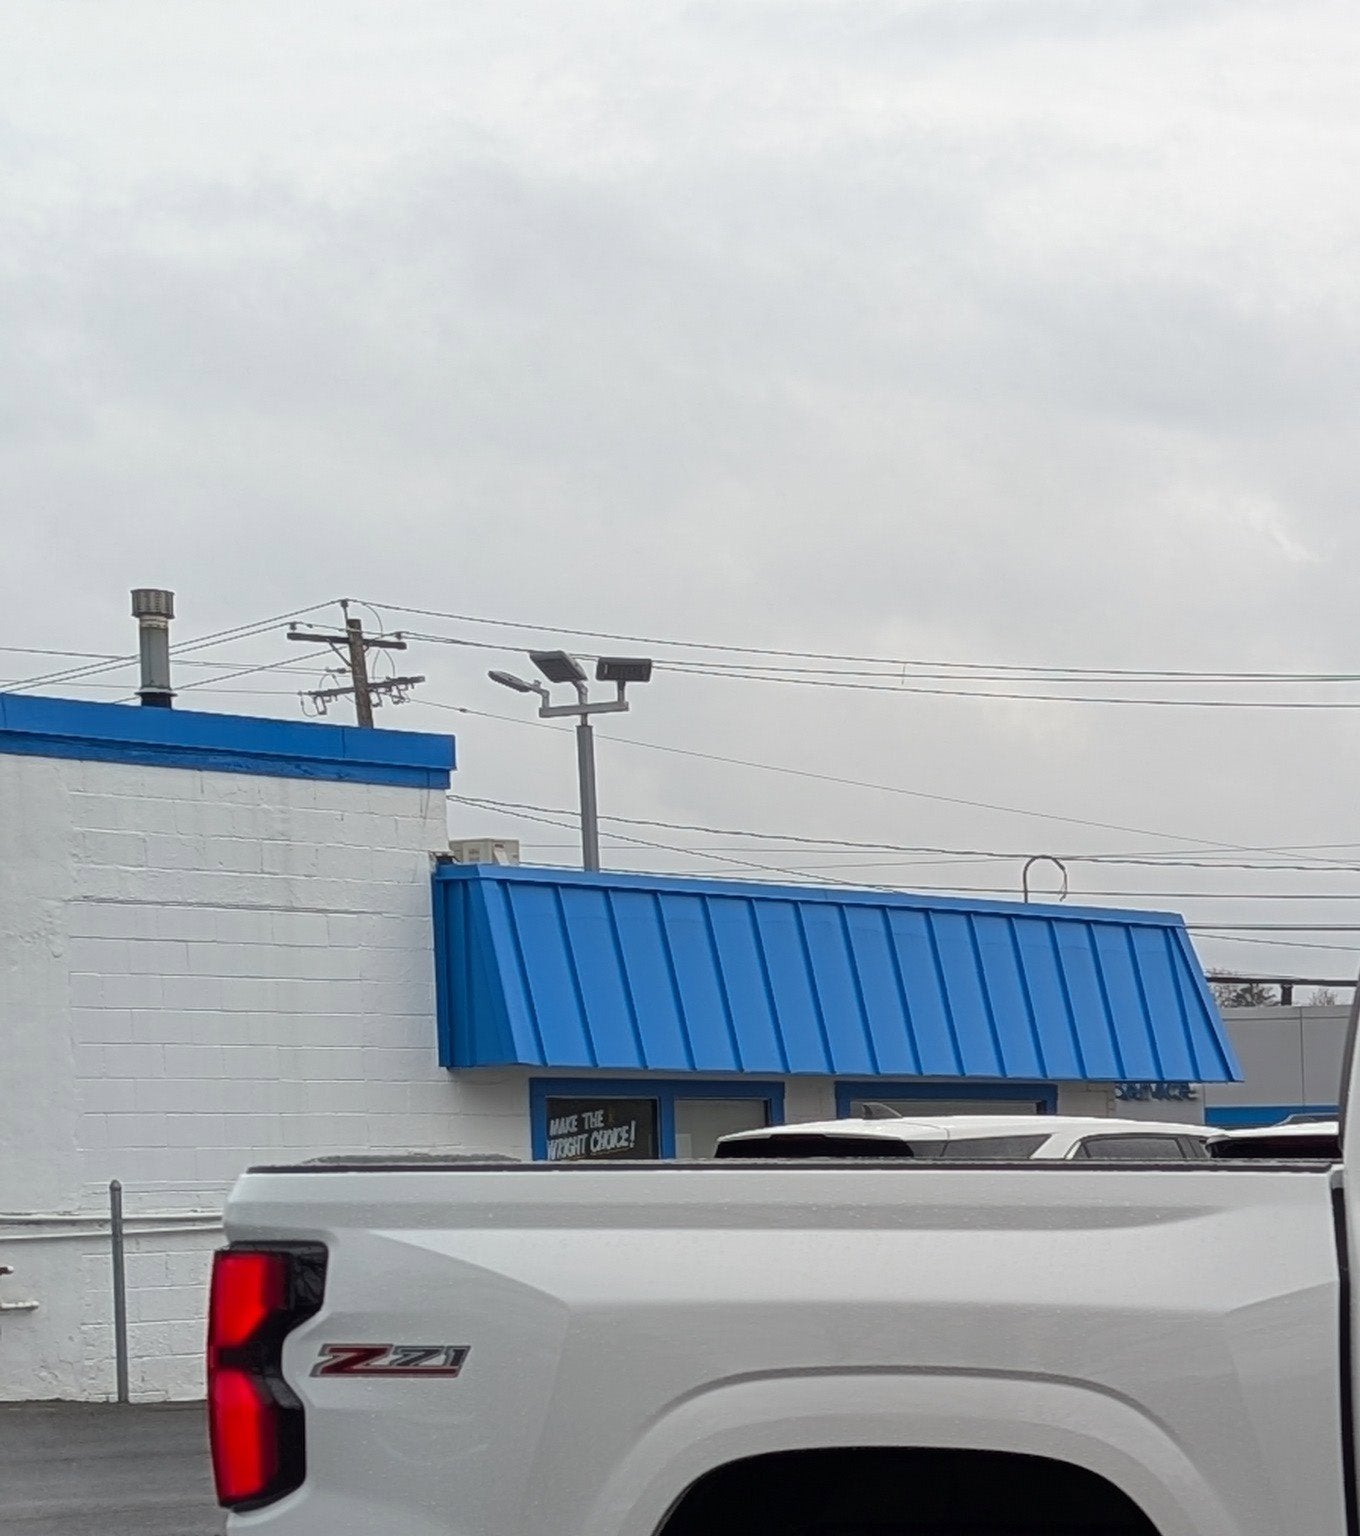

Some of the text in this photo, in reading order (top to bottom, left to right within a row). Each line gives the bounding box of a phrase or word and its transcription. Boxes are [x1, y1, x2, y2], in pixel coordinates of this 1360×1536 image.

[549, 1109, 605, 1137] MAKE THE
[590, 1120, 637, 1153] CHOICE!
[309, 1343, 471, 1378] Z71
